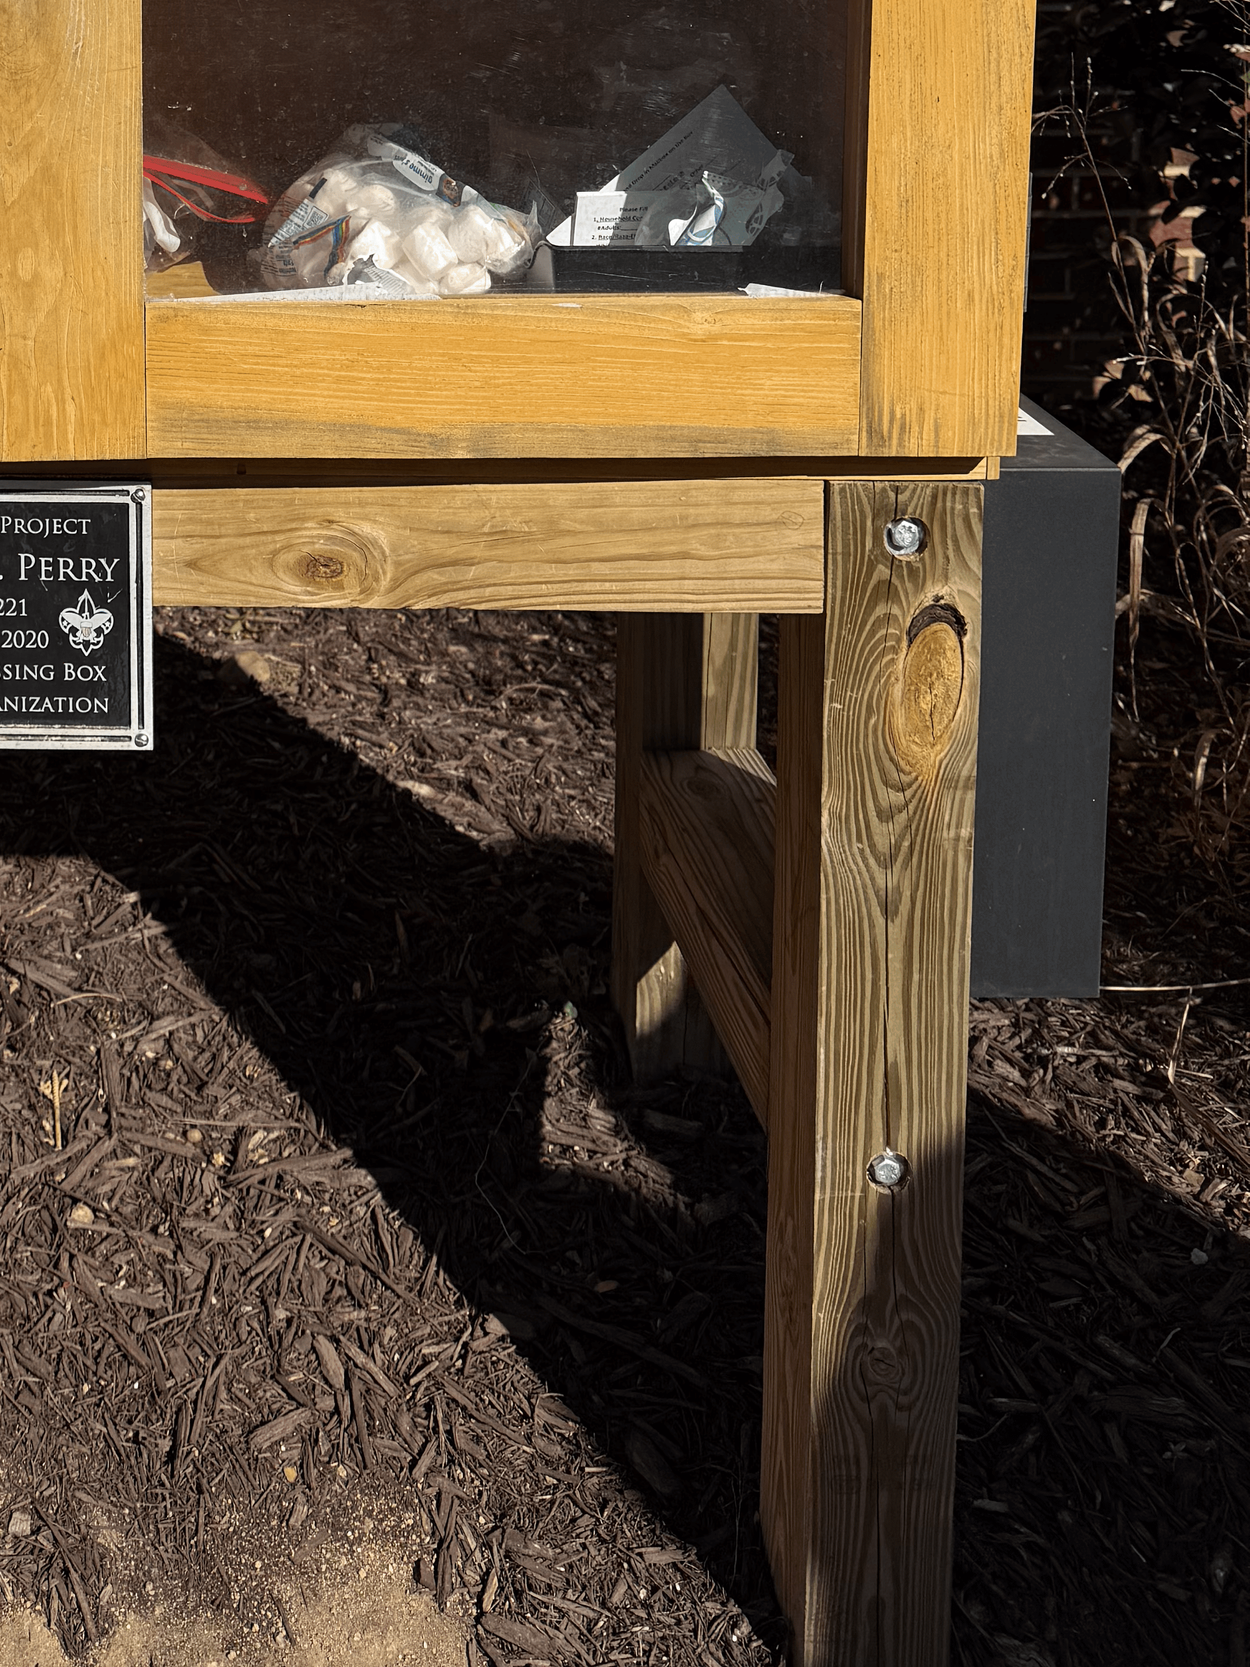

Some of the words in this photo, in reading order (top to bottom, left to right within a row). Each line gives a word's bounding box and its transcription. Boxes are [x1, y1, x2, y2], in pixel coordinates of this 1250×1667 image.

[0, 516, 91, 539] PROJECT
[18, 553, 120, 582] PERRY
[1, 630, 49, 649] 2020
[63, 663, 107, 682] BOX
